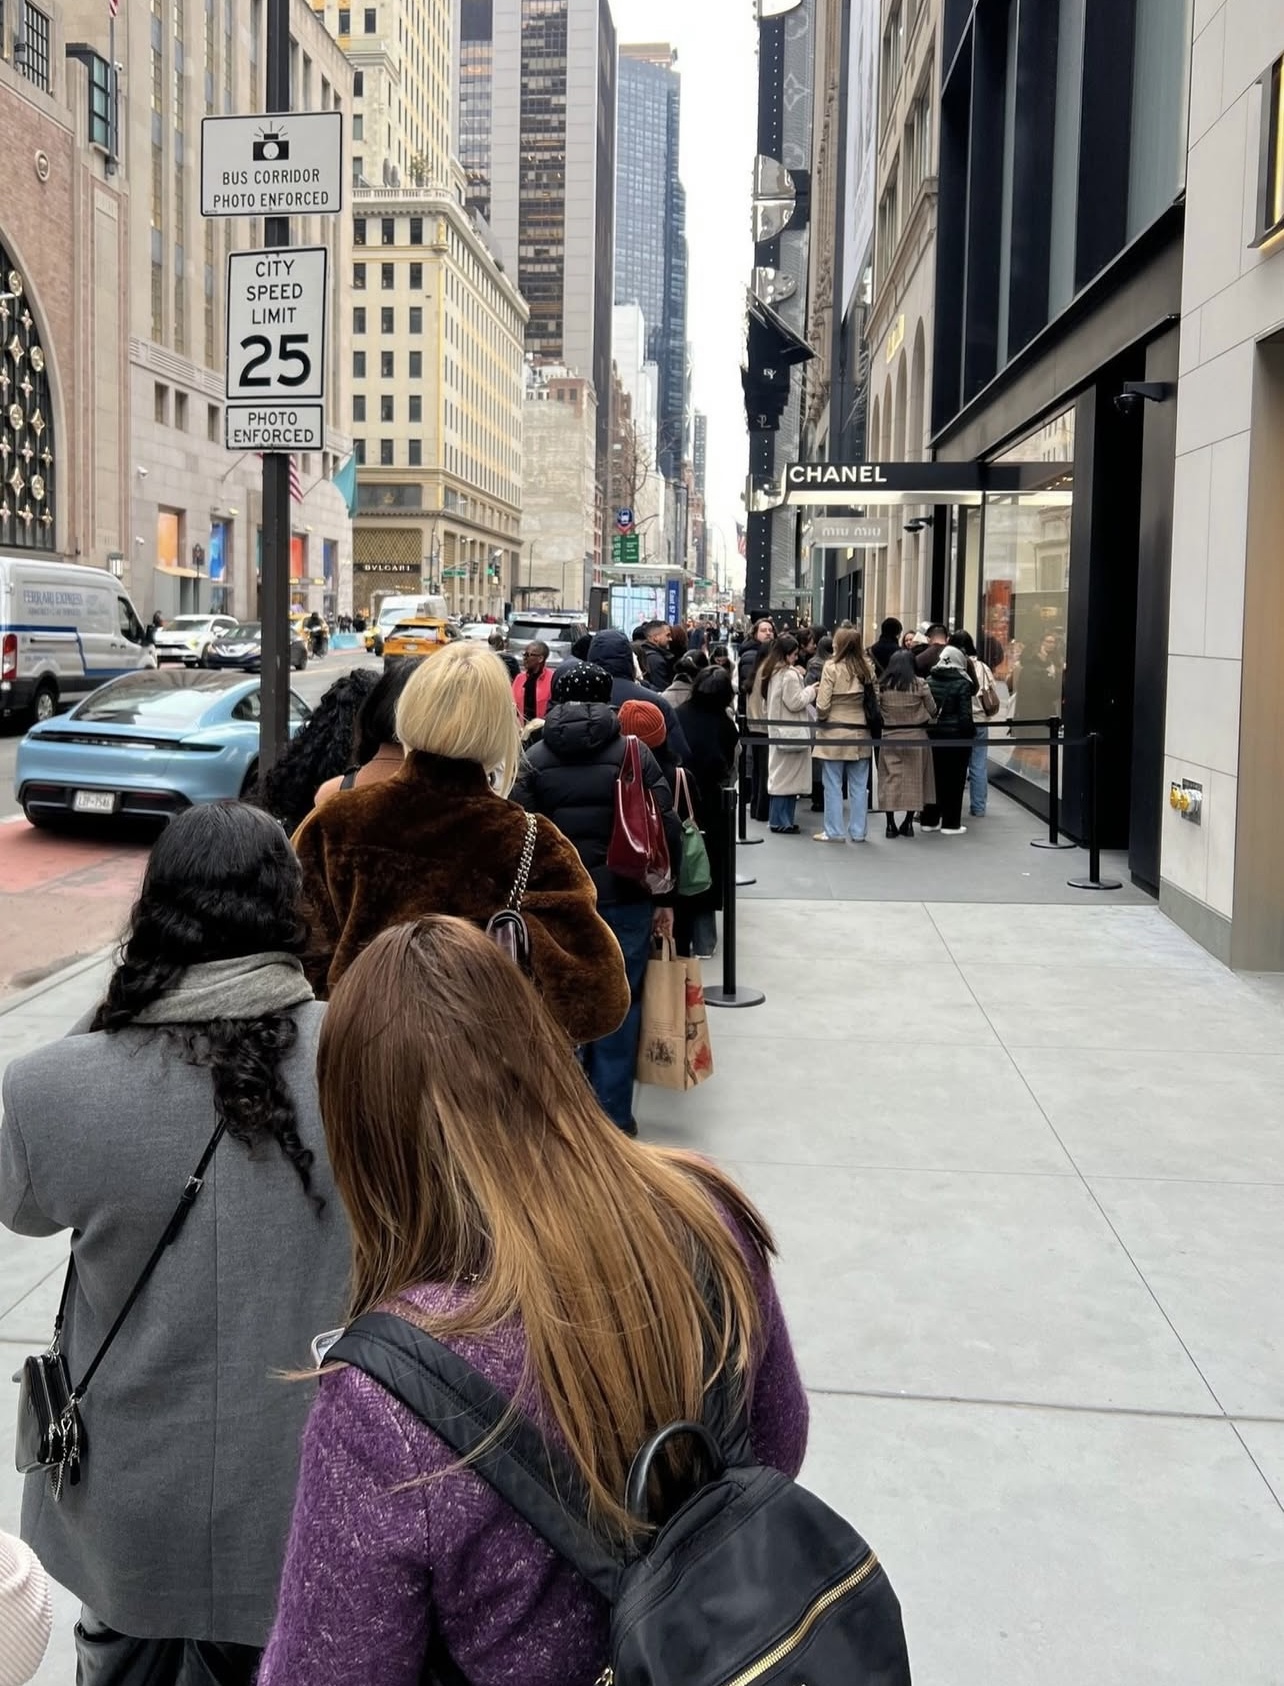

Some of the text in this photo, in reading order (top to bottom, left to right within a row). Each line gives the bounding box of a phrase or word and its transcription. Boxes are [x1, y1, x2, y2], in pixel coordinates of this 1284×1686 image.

[222, 168, 320, 186] BUS CORRIDOR
[213, 190, 329, 208] PHOTO ENFORCED
[255, 259, 295, 278] CITY
[246, 283, 303, 301] SPEED
[252, 307, 297, 324] LIMIT
[239, 333, 312, 388] 25
[248, 412, 298, 426] PHOTO
[234, 428, 314, 443] ENFORCED
[789, 465, 887, 483] CHANEL
